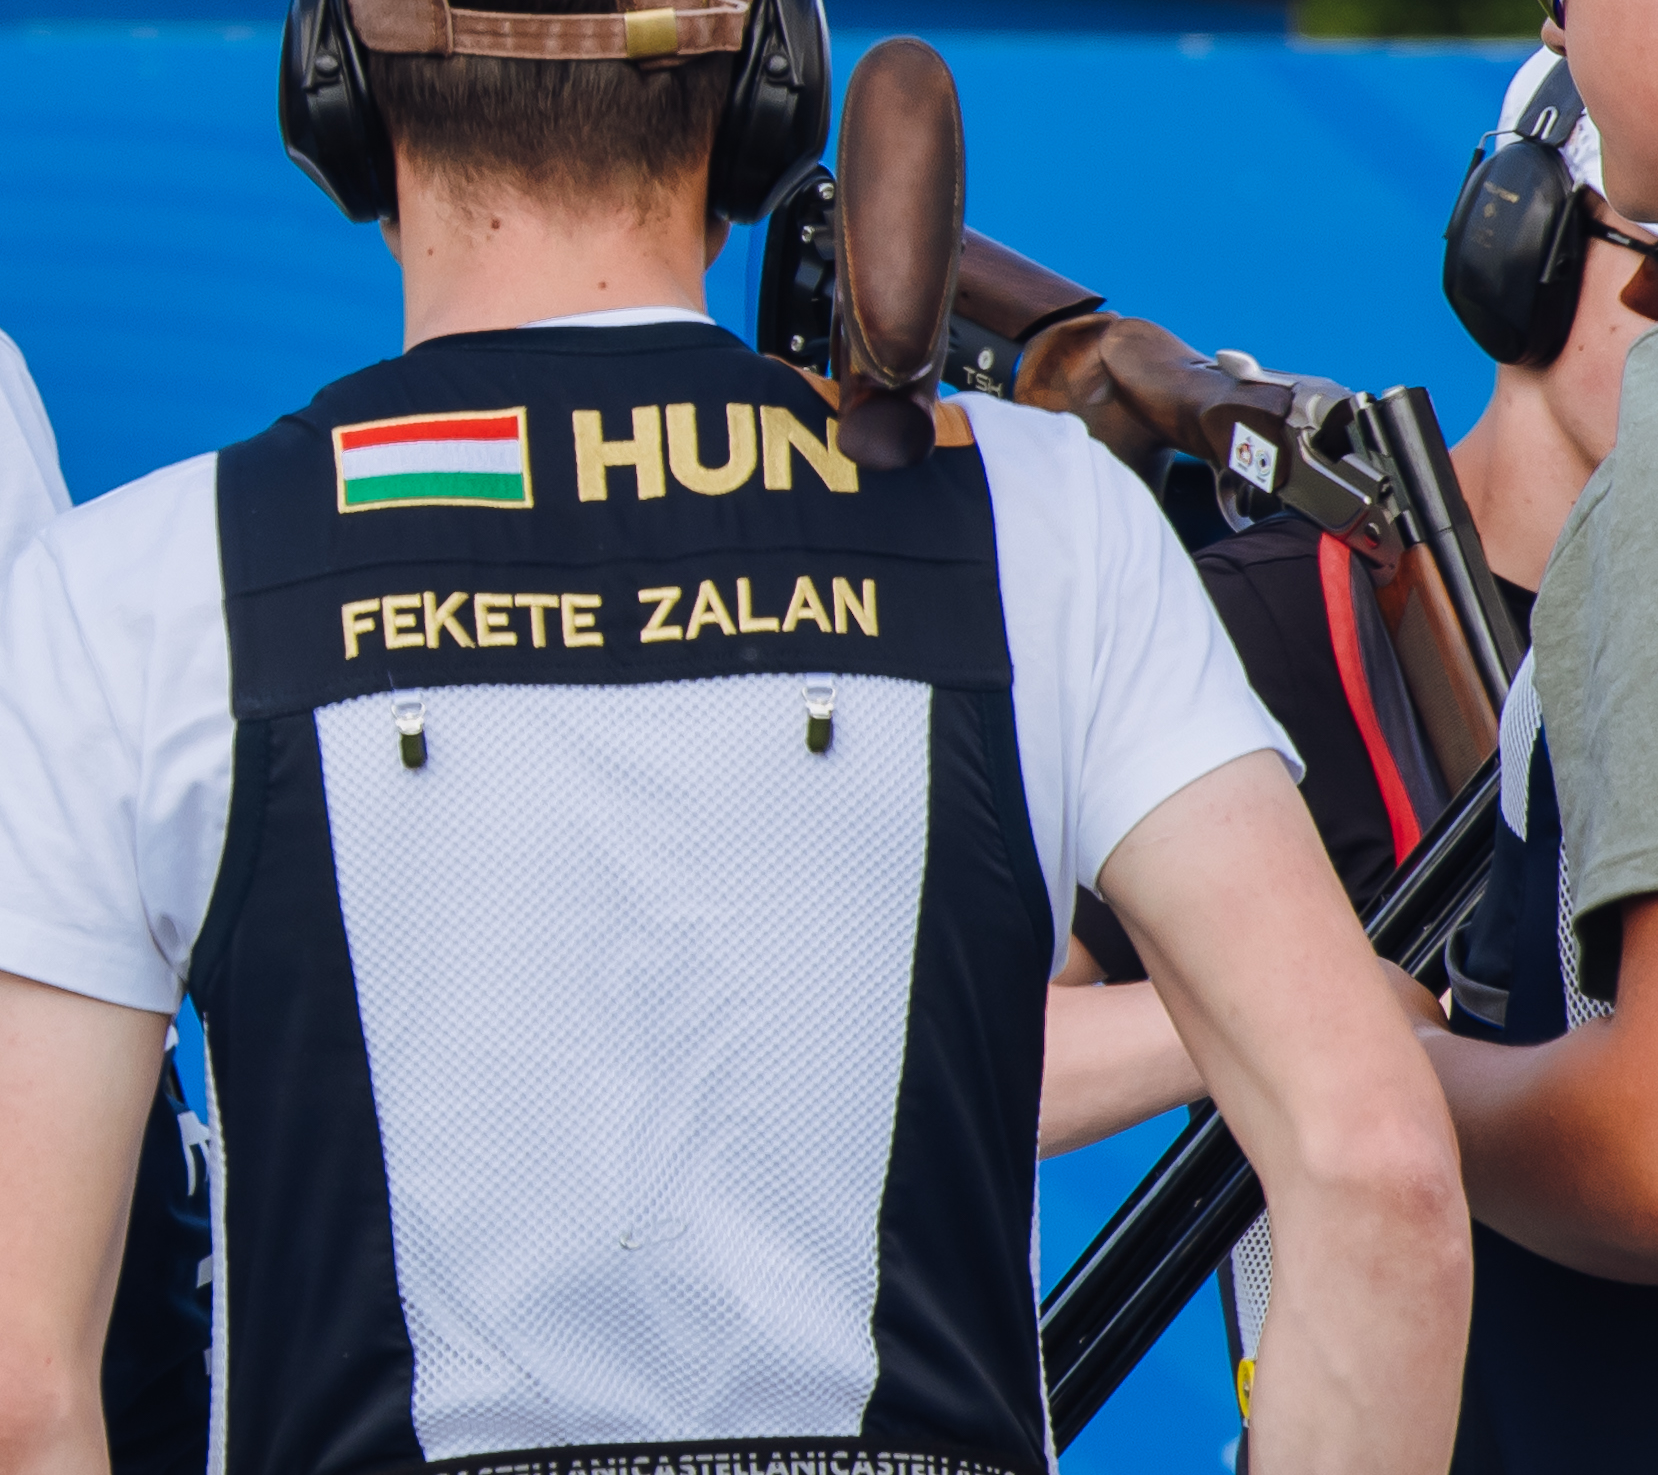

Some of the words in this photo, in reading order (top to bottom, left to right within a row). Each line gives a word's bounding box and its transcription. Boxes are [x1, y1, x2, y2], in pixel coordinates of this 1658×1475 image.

[572, 402, 860, 503] HUN
[341, 591, 604, 661] FEKETE
[638, 576, 879, 644] ZALAN
